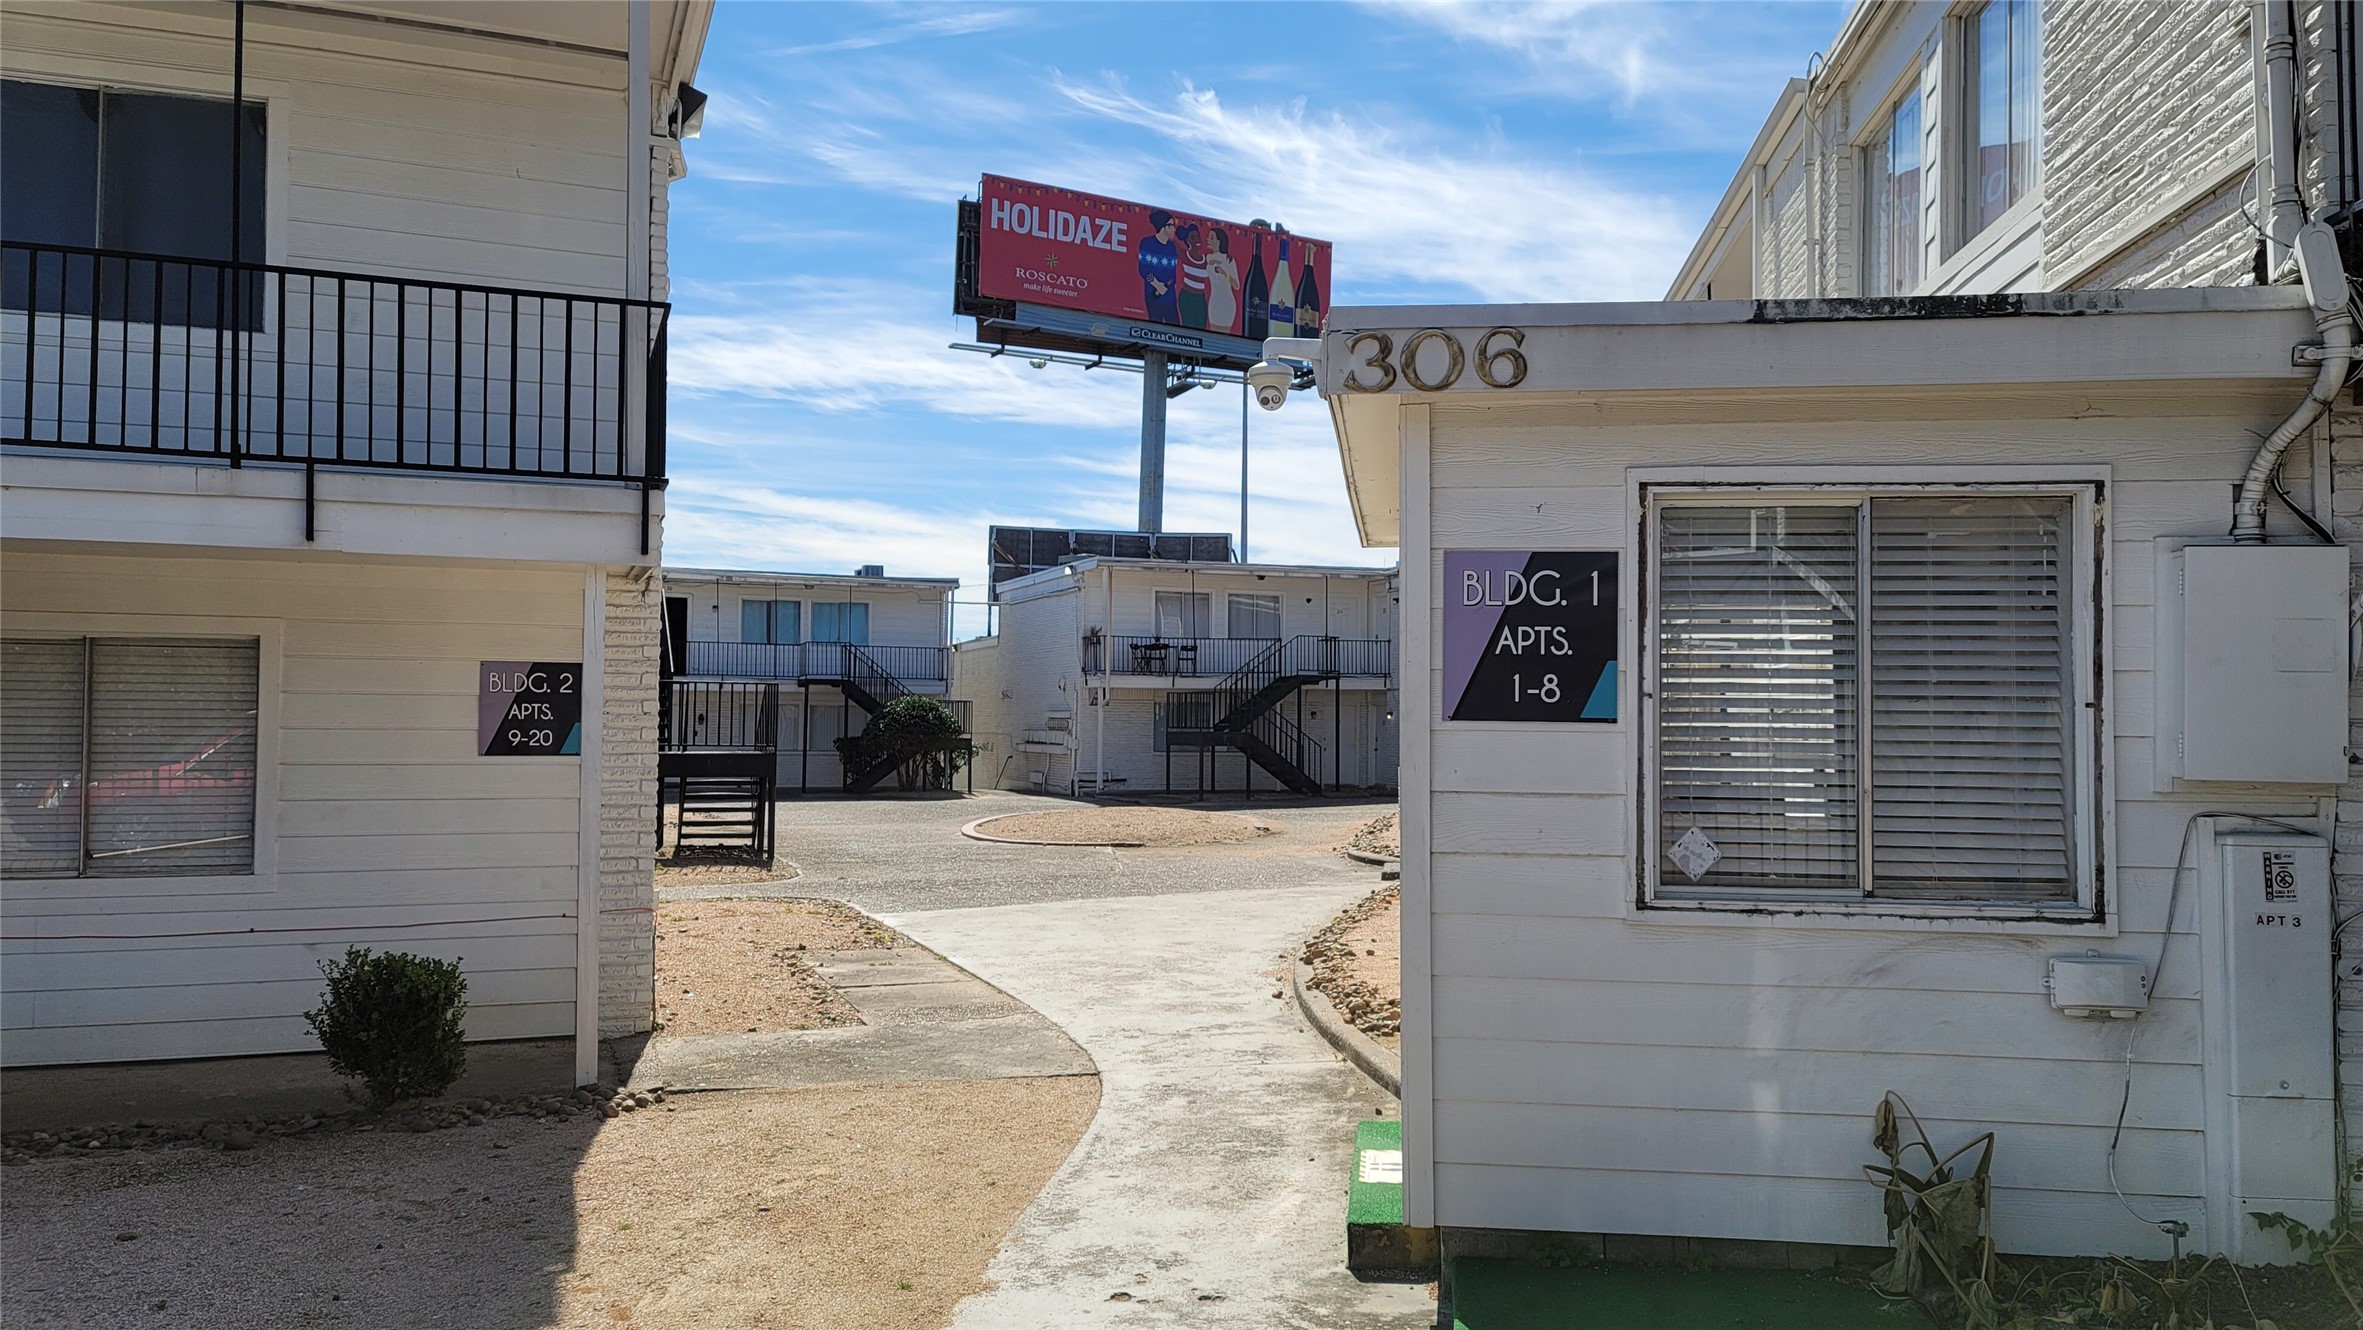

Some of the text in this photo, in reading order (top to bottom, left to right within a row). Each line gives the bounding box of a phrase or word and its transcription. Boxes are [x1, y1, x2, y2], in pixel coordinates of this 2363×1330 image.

[991, 198, 1128, 253] HOLIDAZE
[1015, 267, 1088, 289] ROSCATO
[1023, 282, 1041, 292] make
[1042, 284, 1053, 294] life
[1343, 328, 1528, 394] 306
[1463, 569, 1599, 606] BLDG. 1
[1495, 625, 1573, 656] APTS.
[489, 672, 573, 693] BLDG. 2
[1513, 673, 1561, 704] 1-8
[508, 703, 554, 720] APTS.
[508, 729, 553, 747] 9-20
[2264, 853, 2274, 899] WARNING
[2256, 914, 2301, 928] APT 3
